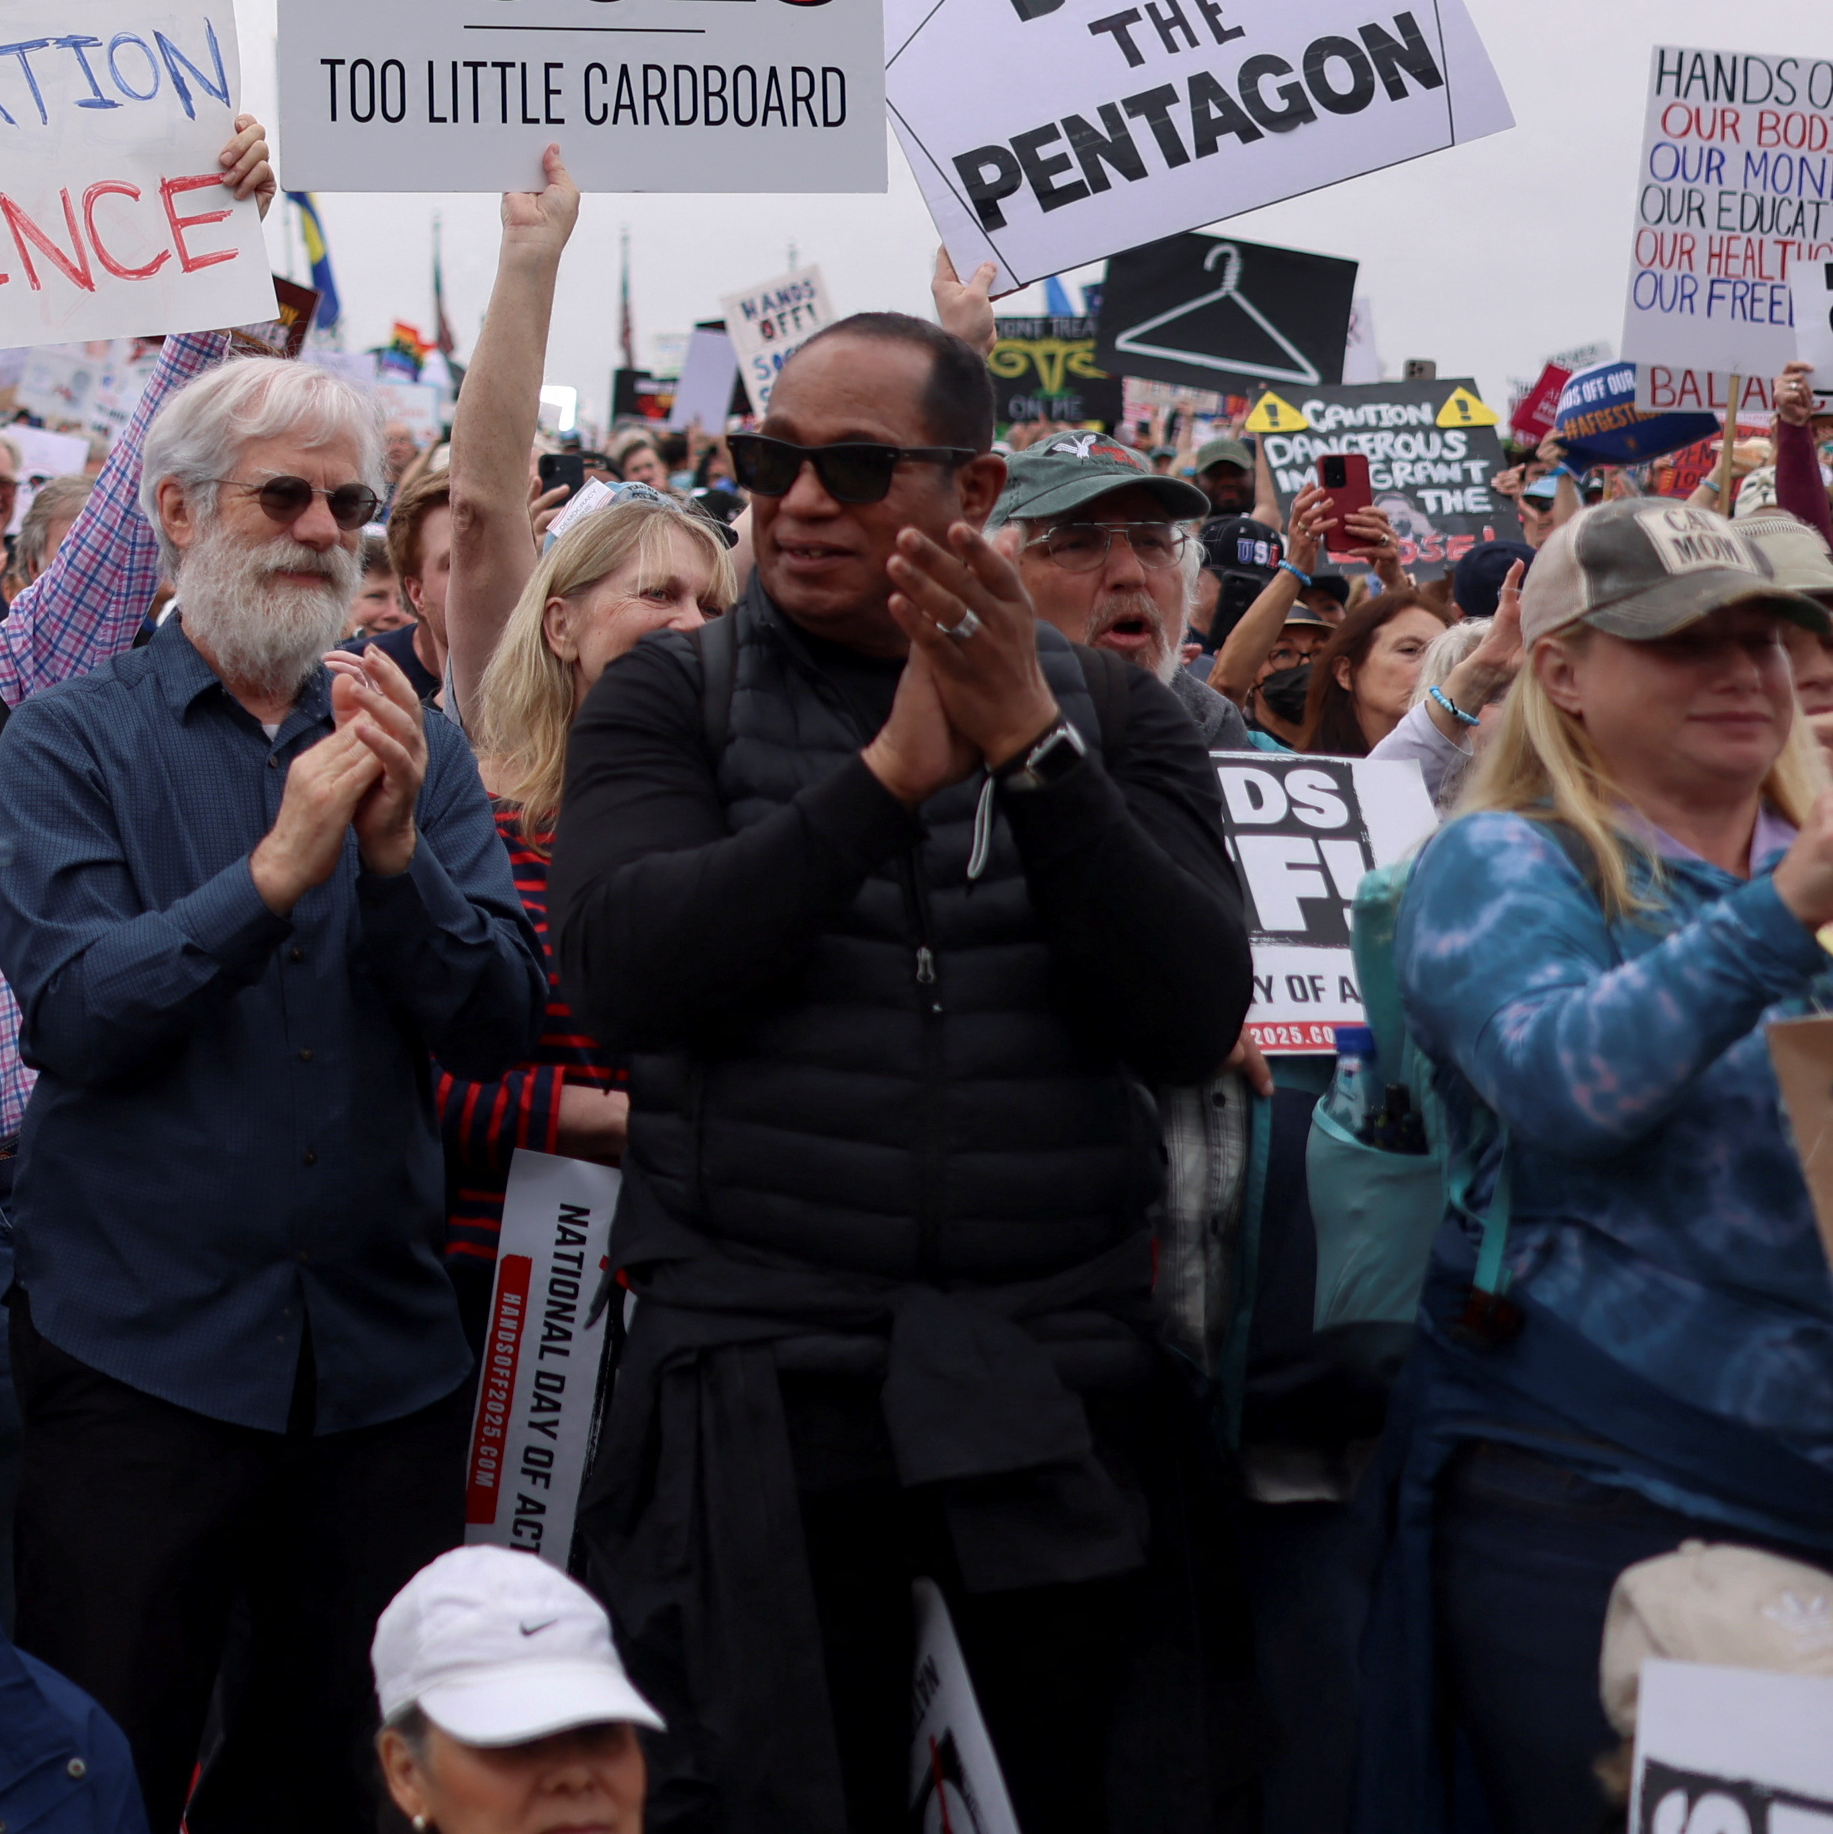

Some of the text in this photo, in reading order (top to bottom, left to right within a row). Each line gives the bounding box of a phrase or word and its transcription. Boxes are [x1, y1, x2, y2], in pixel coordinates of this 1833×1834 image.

[320, 57, 848, 128] TOO LITTLE CARDBOARD
[1655, 48, 1799, 106] HANDS
[951, 11, 1445, 233] PENTAGON
[1661, 101, 1833, 155] OUR BOD
[1649, 141, 1833, 200] OUR MON
[1640, 183, 1833, 242] OUR EDUCAT
[1635, 226, 1696, 273] OUR
[741, 280, 817, 321] HANDS
[1633, 269, 1795, 328] OUR FREE
[760, 302, 819, 340] OFF!
[1050, 319, 1097, 339] TREA
[1008, 394, 1083, 420] ON ME
[1582, 369, 1637, 402] OFF OUR
[1301, 399, 1434, 432] CAUTION
[1263, 430, 1469, 469] DANGEROUS
[1276, 460, 1490, 494] IMGRANT
[559, 488, 598, 530] DEMOCRACY
[1417, 487, 1493, 514] THE
[1671, 533, 1742, 564] MOM
[1286, 974, 1326, 1004] OF
[538, 1203, 592, 1361] NATIONAL
[475, 1292, 523, 1489] HANDSOFF2025.COM
[527, 1369, 567, 1441] DAY
[520, 1445, 555, 1490] OF
